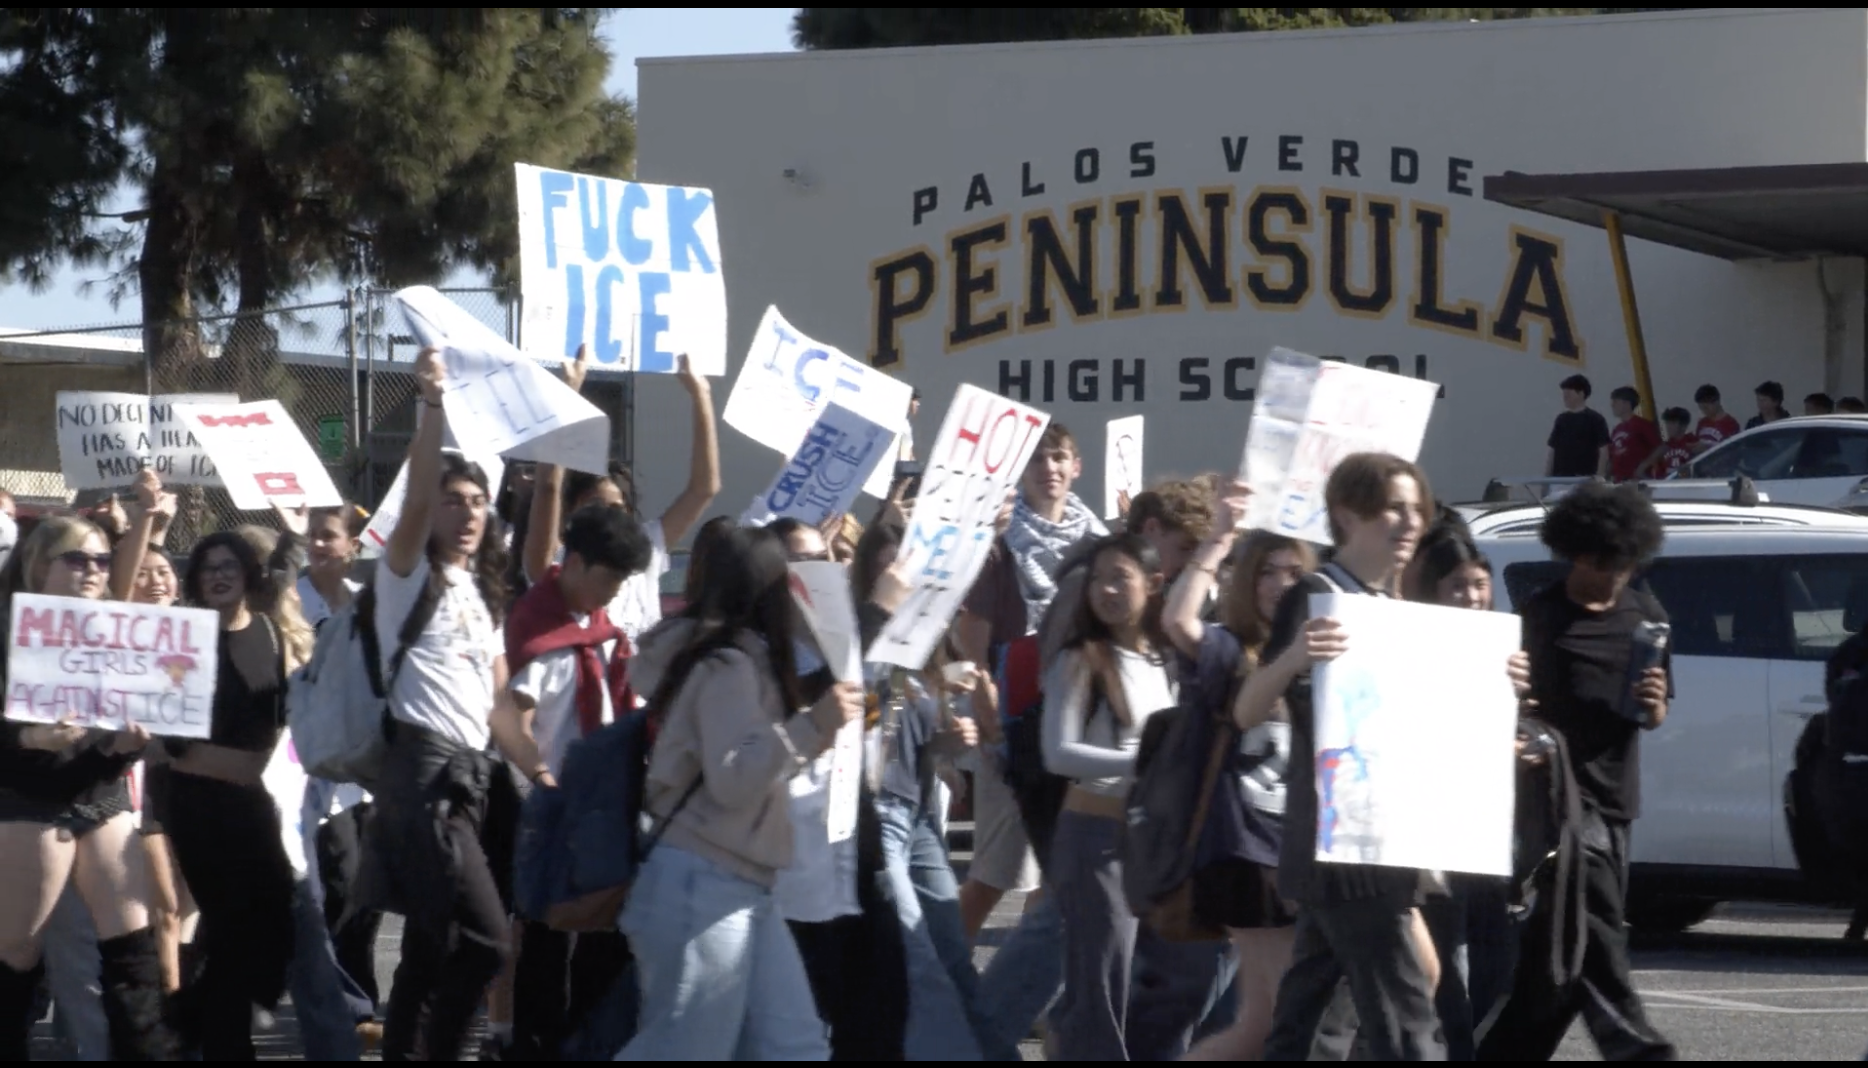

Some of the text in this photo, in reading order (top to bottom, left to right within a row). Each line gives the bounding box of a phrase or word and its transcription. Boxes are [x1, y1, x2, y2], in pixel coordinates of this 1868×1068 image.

[912, 134, 1515, 226] PALOS VERDE
[540, 171, 716, 274] FUCK
[867, 184, 1586, 370] PENINSULA
[564, 264, 674, 371] ICE
[1000, 358, 1145, 402] HIGH
[58, 404, 96, 429] NO
[949, 394, 1042, 478] HOT
[81, 432, 126, 457] HAS
[136, 432, 151, 450] A
[156, 455, 175, 473] OF
[767, 421, 840, 512] CRUSH
[16, 606, 200, 654] MAGICAL
[59, 651, 149, 676] GIRLS
[6, 683, 204, 725] AGAINST ICE
